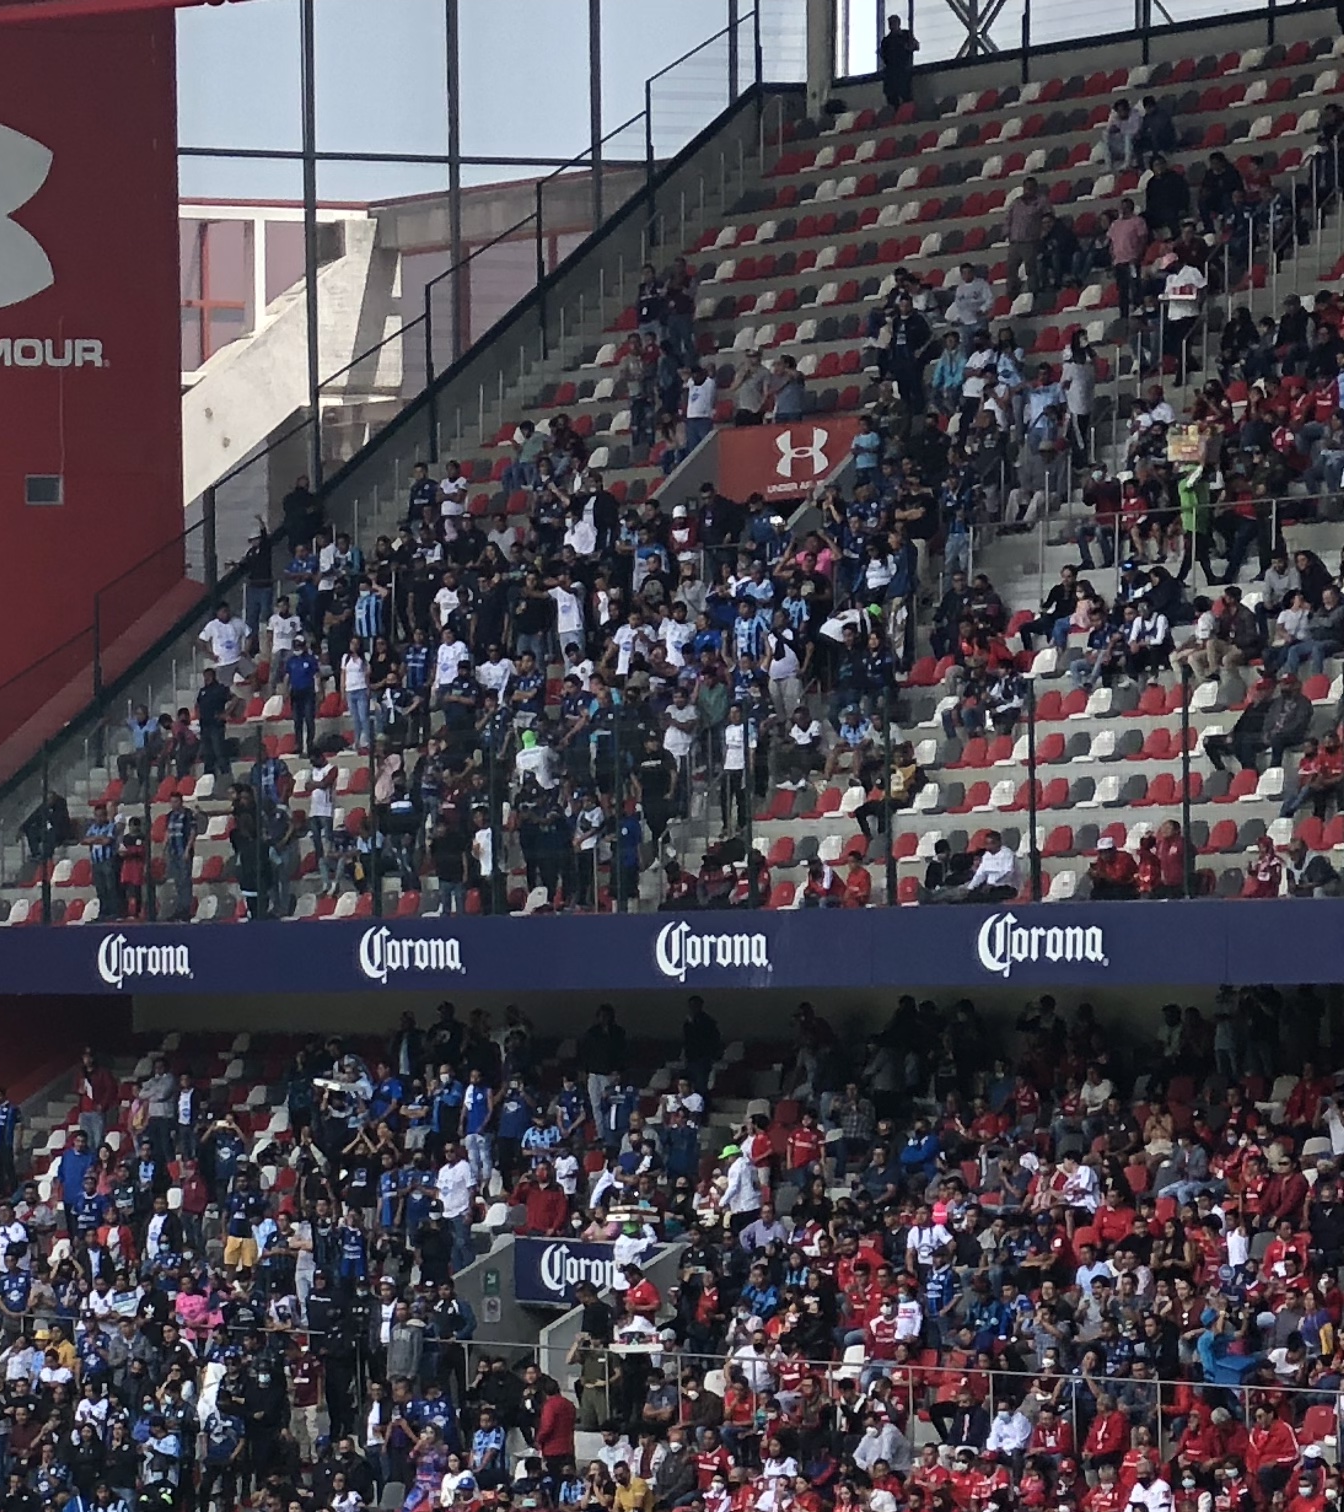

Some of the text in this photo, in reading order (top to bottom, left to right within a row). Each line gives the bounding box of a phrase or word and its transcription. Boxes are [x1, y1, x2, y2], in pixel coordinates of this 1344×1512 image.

[97, 932, 192, 989] Corona
[359, 925, 463, 985] Corona
[655, 920, 770, 983] Corona
[977, 911, 1106, 978] Corona
[541, 1243, 617, 1297] Coron
